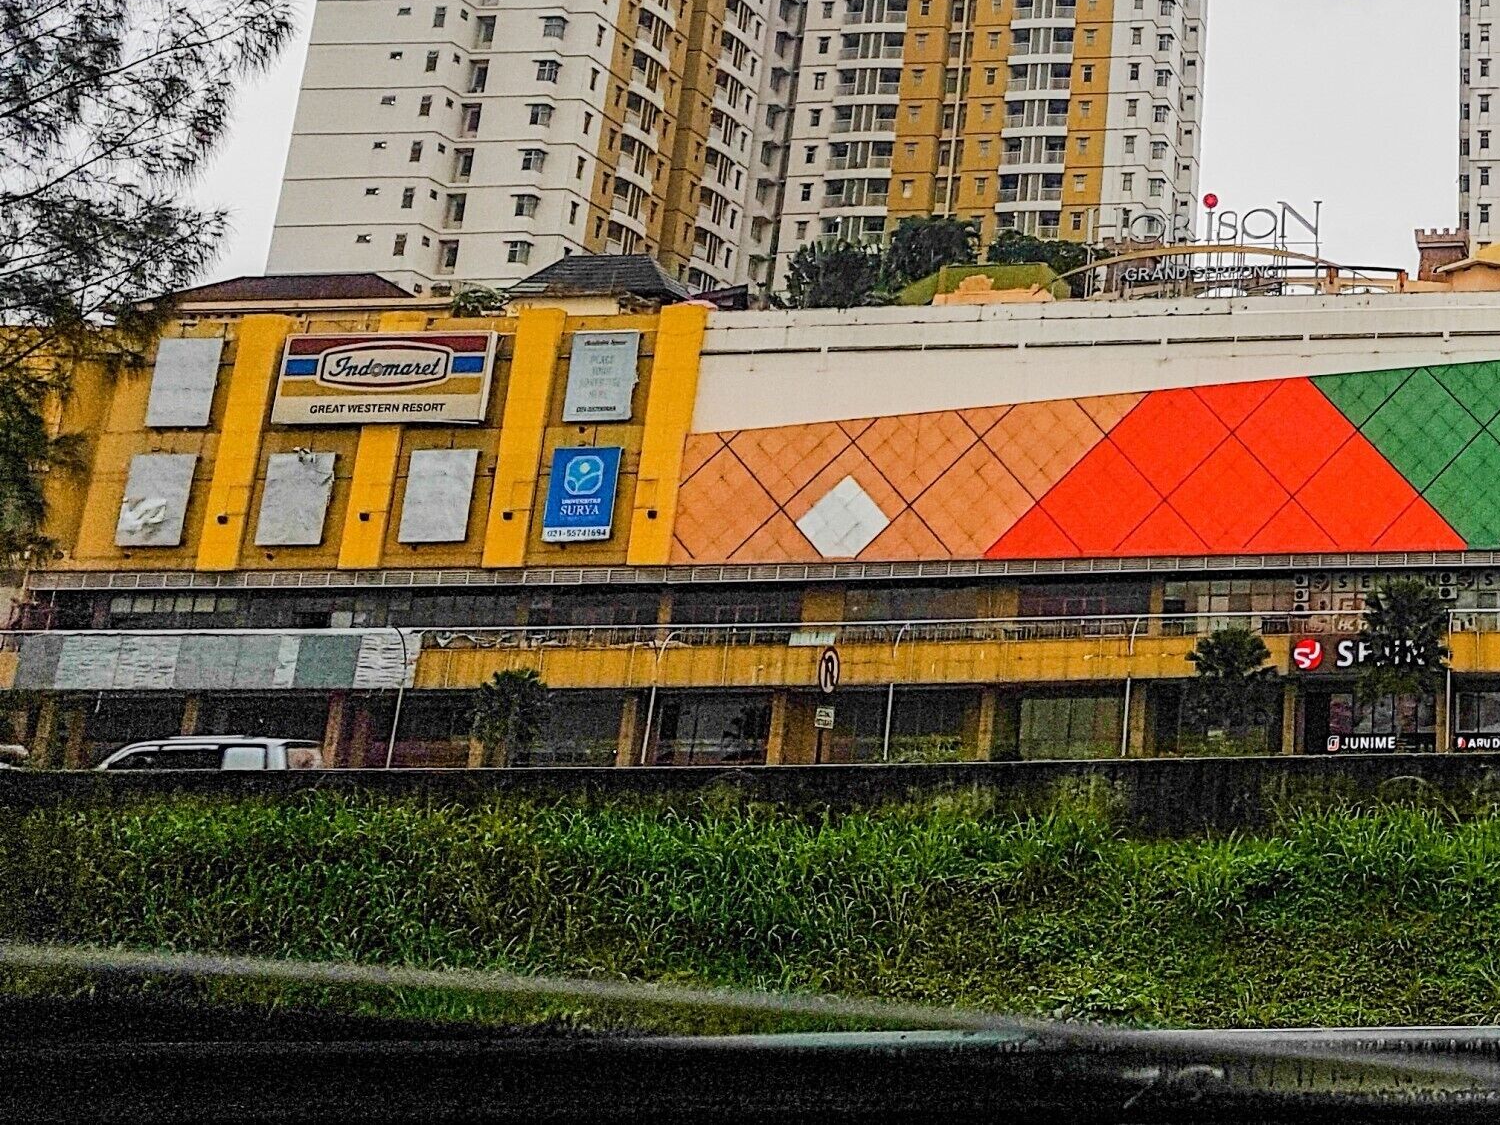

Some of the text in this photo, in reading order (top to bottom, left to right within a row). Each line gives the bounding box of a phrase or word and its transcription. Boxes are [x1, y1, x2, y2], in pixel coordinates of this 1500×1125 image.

[1125, 265, 1278, 281] GRAND SERPONG
[328, 355, 441, 377] Indomaret
[309, 402, 446, 414] GREAT WESTERN RESORT
[559, 504, 600, 515] SURYA
[1341, 735, 1396, 749] JUNIME
[1468, 737, 1490, 749] ARU
